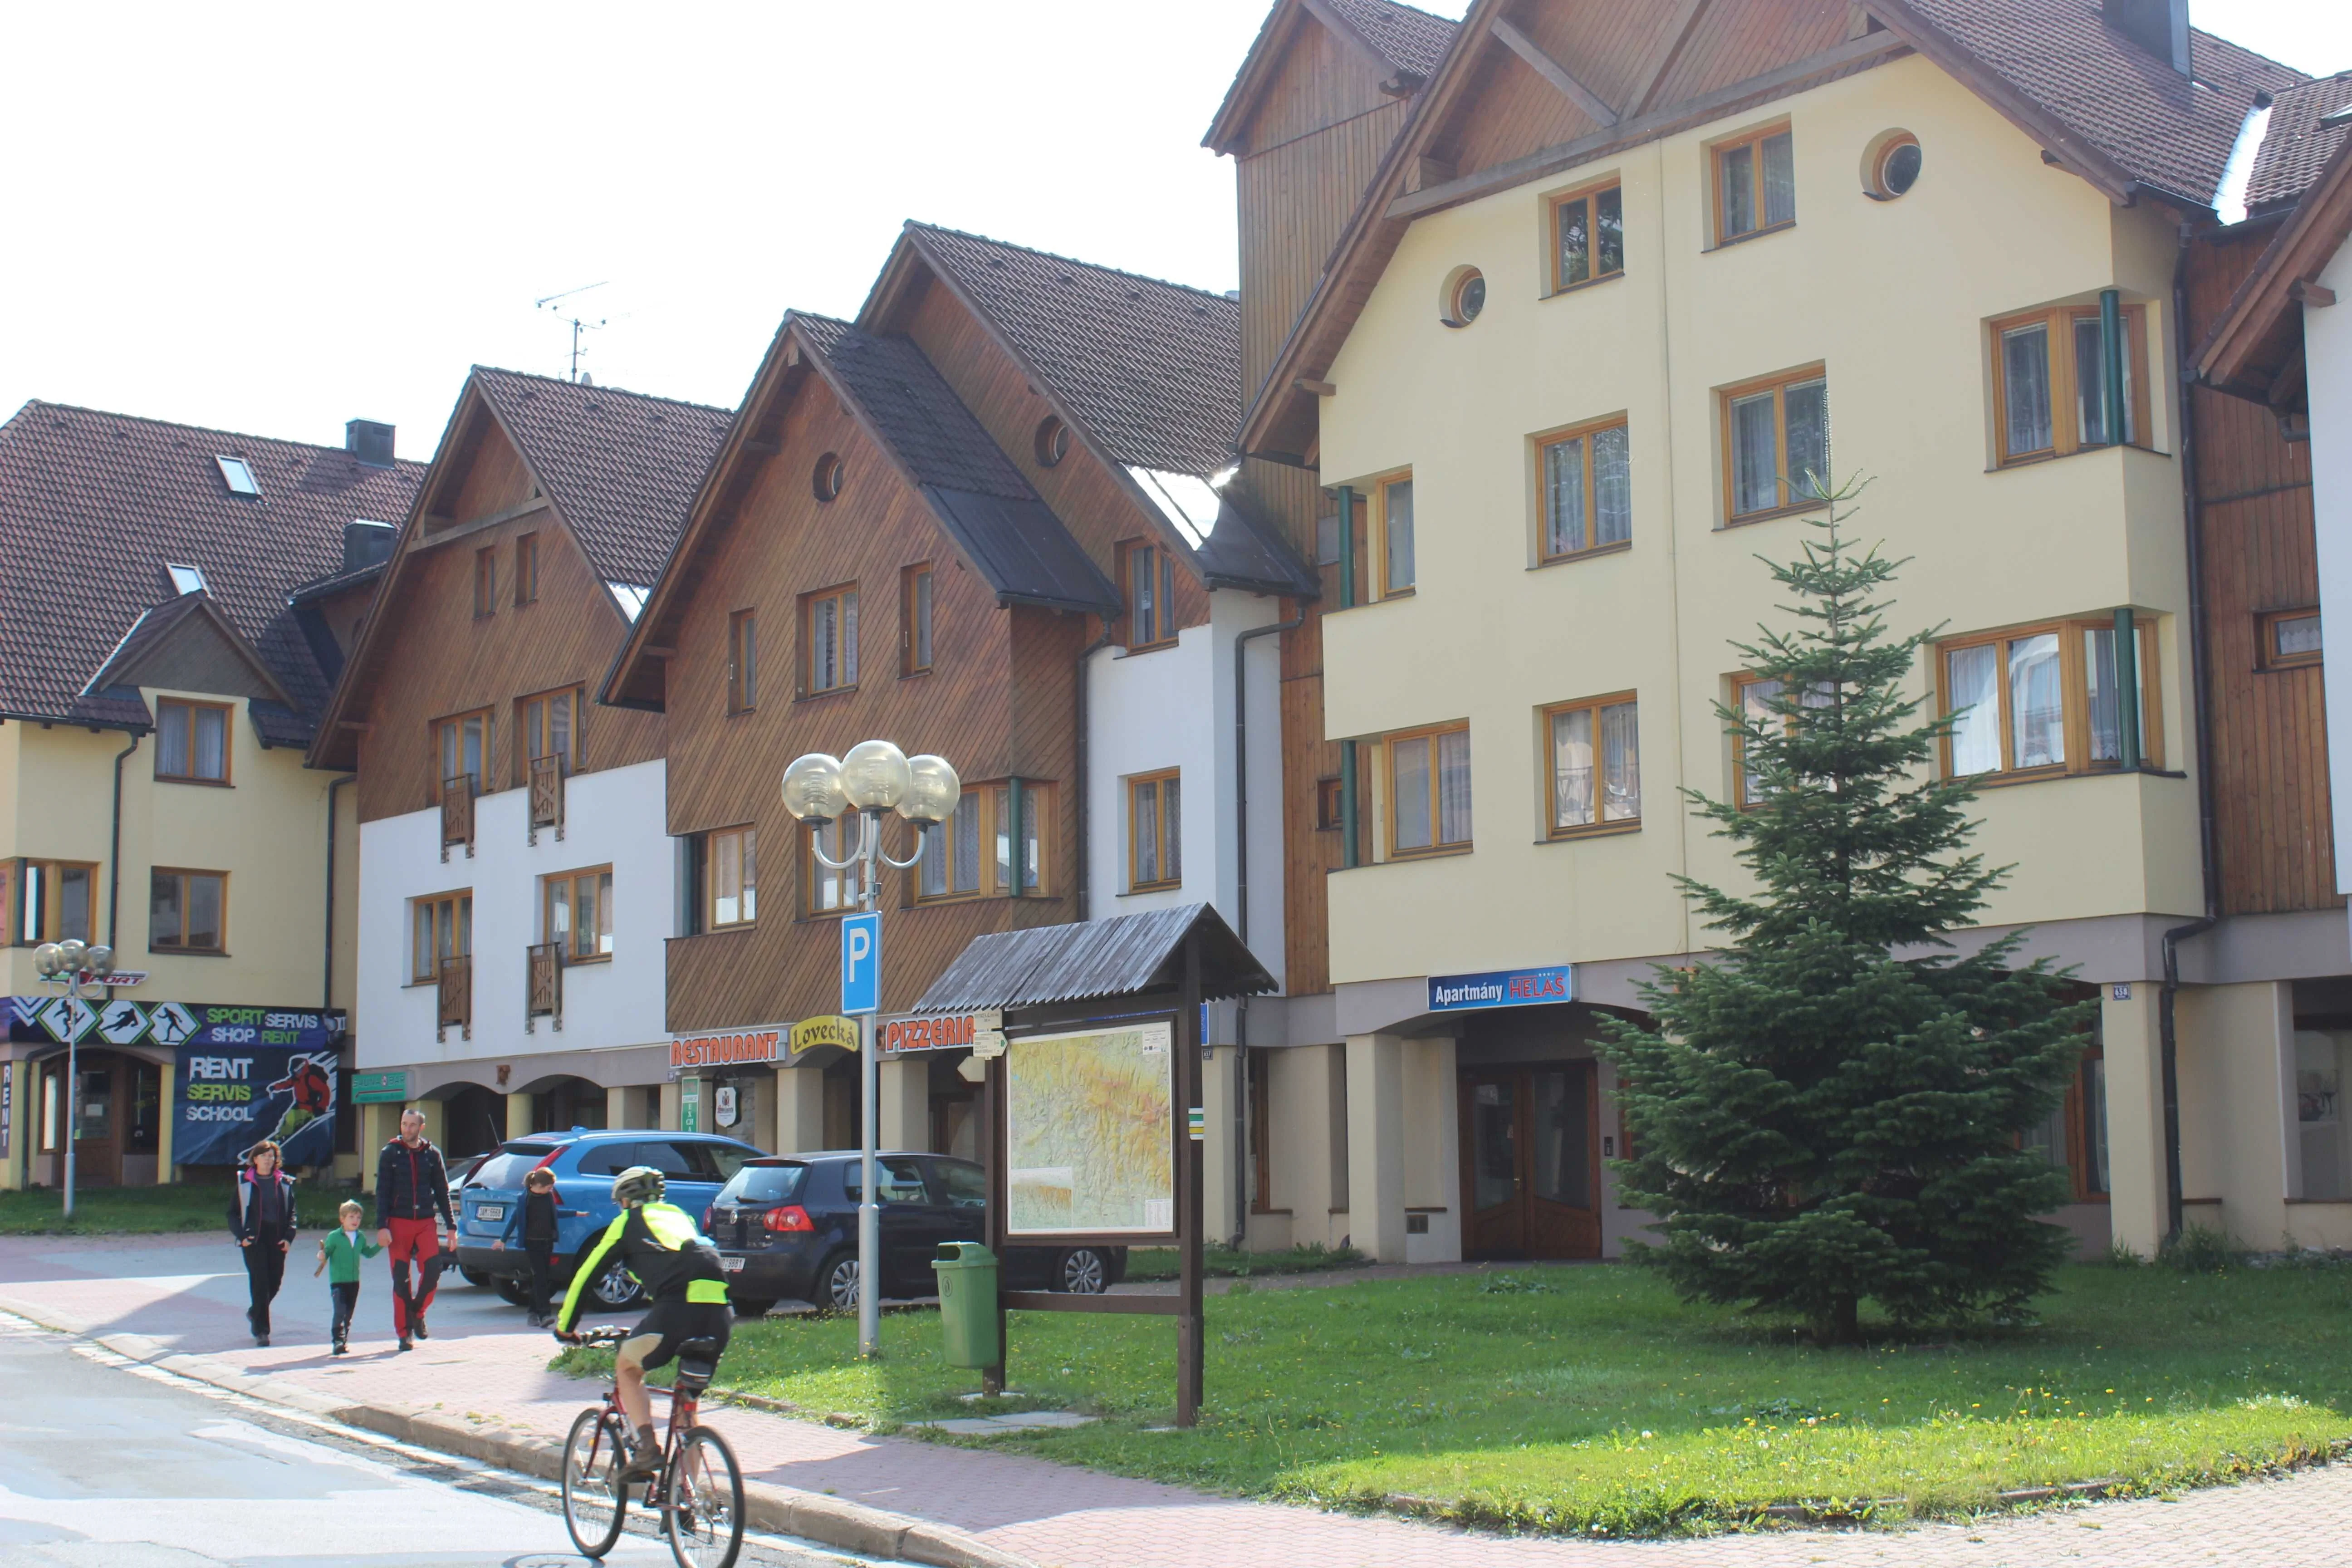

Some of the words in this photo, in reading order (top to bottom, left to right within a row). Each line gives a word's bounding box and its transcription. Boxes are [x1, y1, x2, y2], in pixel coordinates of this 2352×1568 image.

[849, 927, 870, 983] P
[1435, 982, 1503, 1006] Apartmány
[1509, 976, 1565, 999] HELAS
[206, 1008, 265, 1025] SPORT
[265, 1013, 318, 1029] SERVIS
[211, 1027, 256, 1043] SHOP
[261, 1029, 300, 1044] RENT
[793, 1017, 855, 1050] Lovecká
[887, 1015, 976, 1051] PIZZERIA
[671, 1032, 779, 1067] RESTAURANT
[189, 1056, 254, 1082] RENT
[389, 1074, 405, 1086] BAR
[1, 1065, 11, 1147] RENT
[186, 1083, 251, 1102] SERVIS
[186, 1105, 254, 1122] SCHOOL
